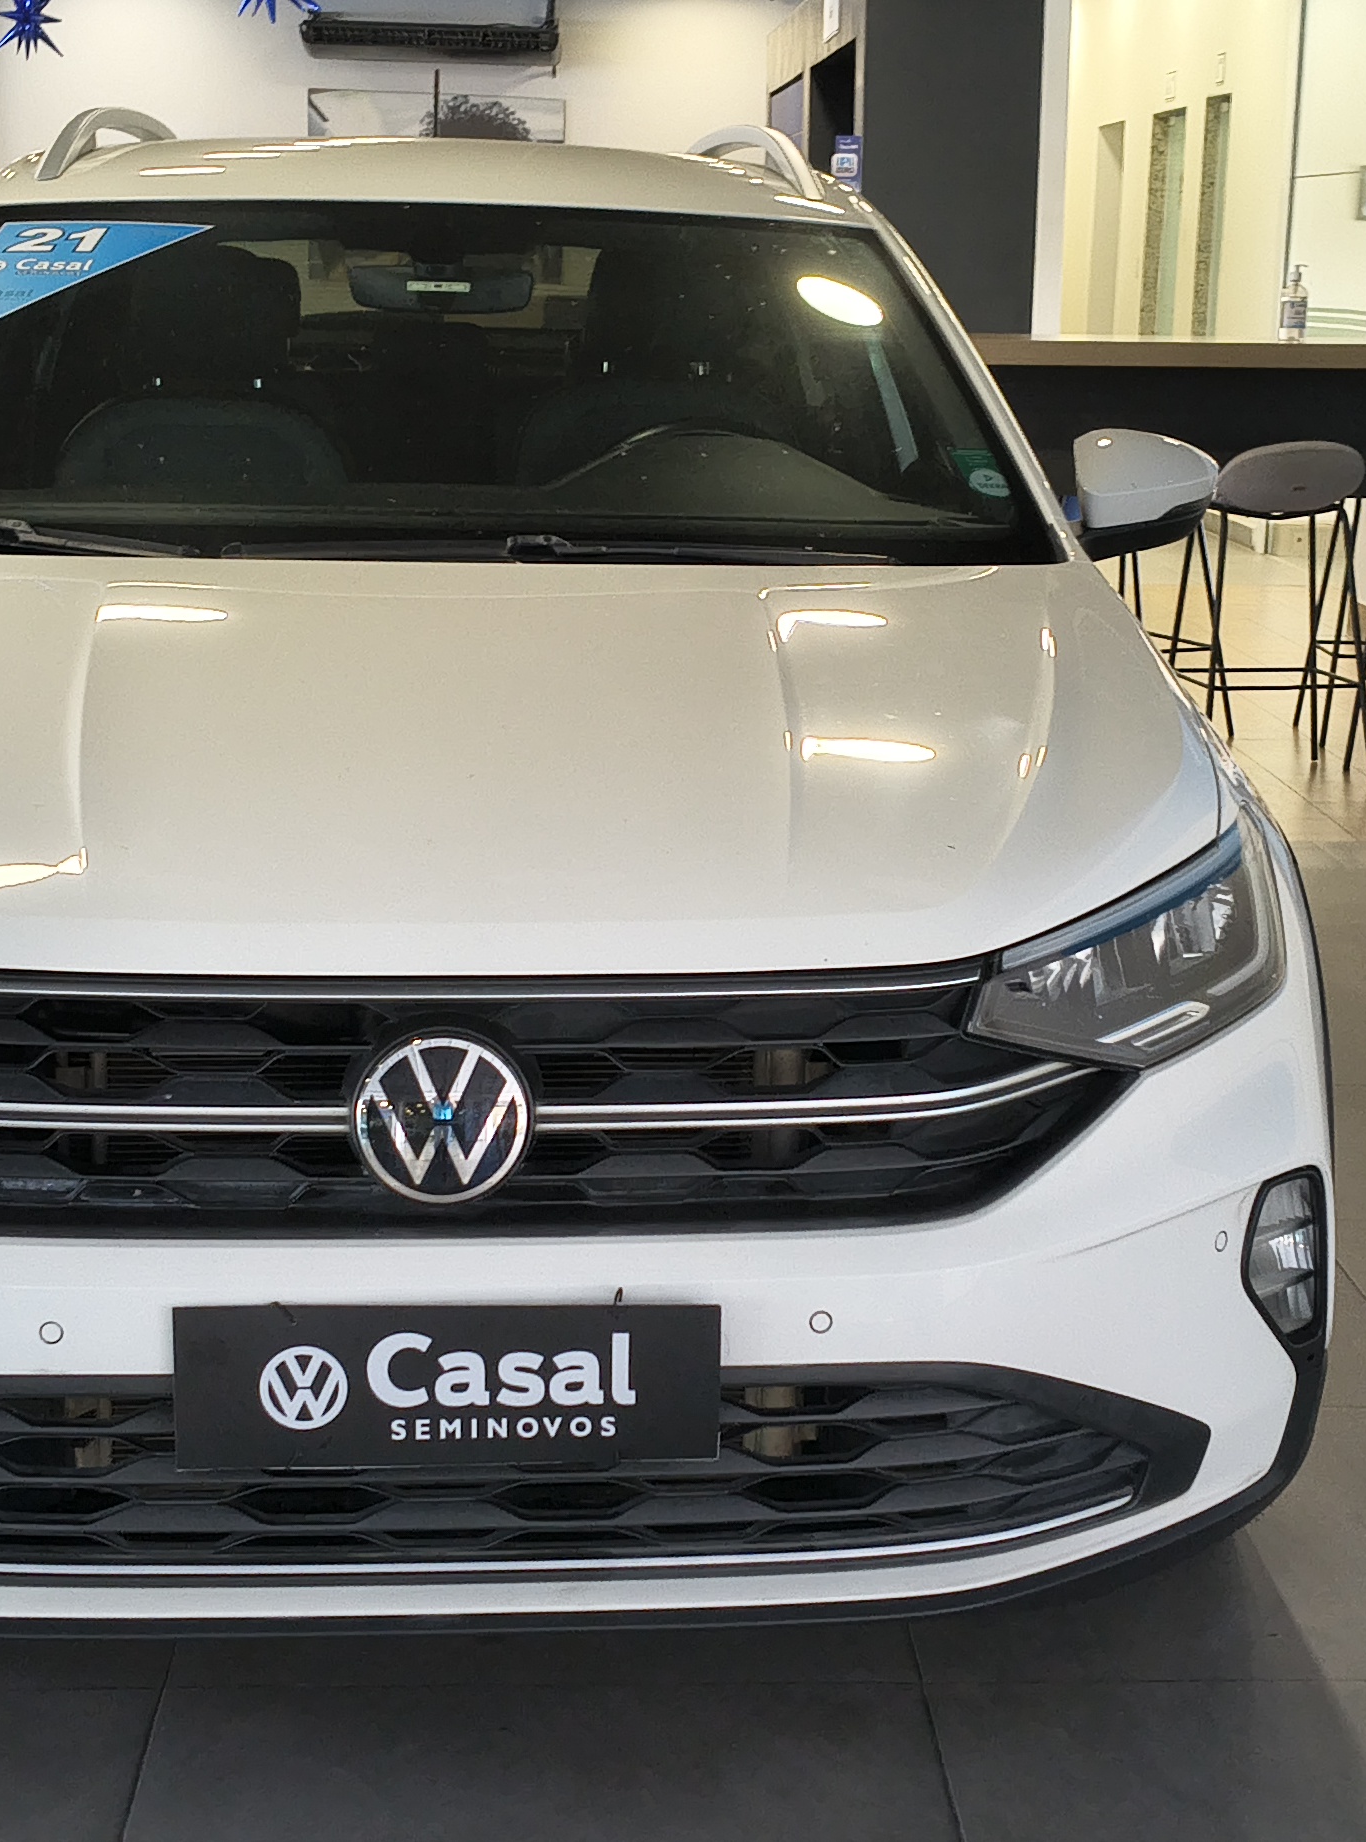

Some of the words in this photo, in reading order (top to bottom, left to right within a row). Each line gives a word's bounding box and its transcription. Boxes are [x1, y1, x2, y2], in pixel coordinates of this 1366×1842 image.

[2, 226, 110, 253] 21
[15, 258, 94, 271] Casal
[366, 1331, 636, 1408] Casal
[390, 1416, 617, 1442] SEMINOVOS
